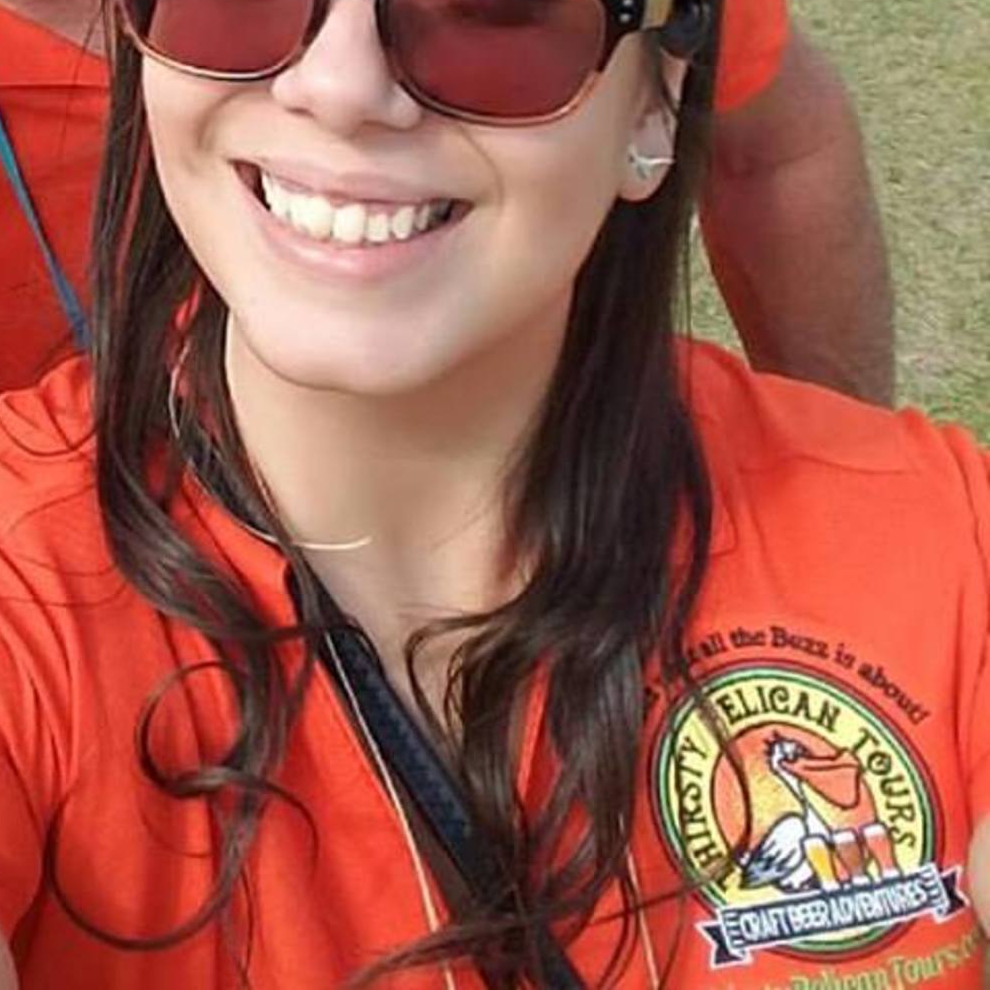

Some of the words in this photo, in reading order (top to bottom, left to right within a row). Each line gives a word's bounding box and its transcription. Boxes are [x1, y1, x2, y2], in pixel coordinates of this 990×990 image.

[699, 631, 729, 657] all
[729, 626, 767, 649] the
[770, 625, 830, 660] Buzz
[834, 643, 857, 669] is
[715, 685, 842, 734] ELICAN
[852, 726, 917, 849] TOURS
[739, 907, 791, 941] CRAFT
[789, 899, 828, 930] BEER
[827, 878, 929, 927] ADVENTURES
